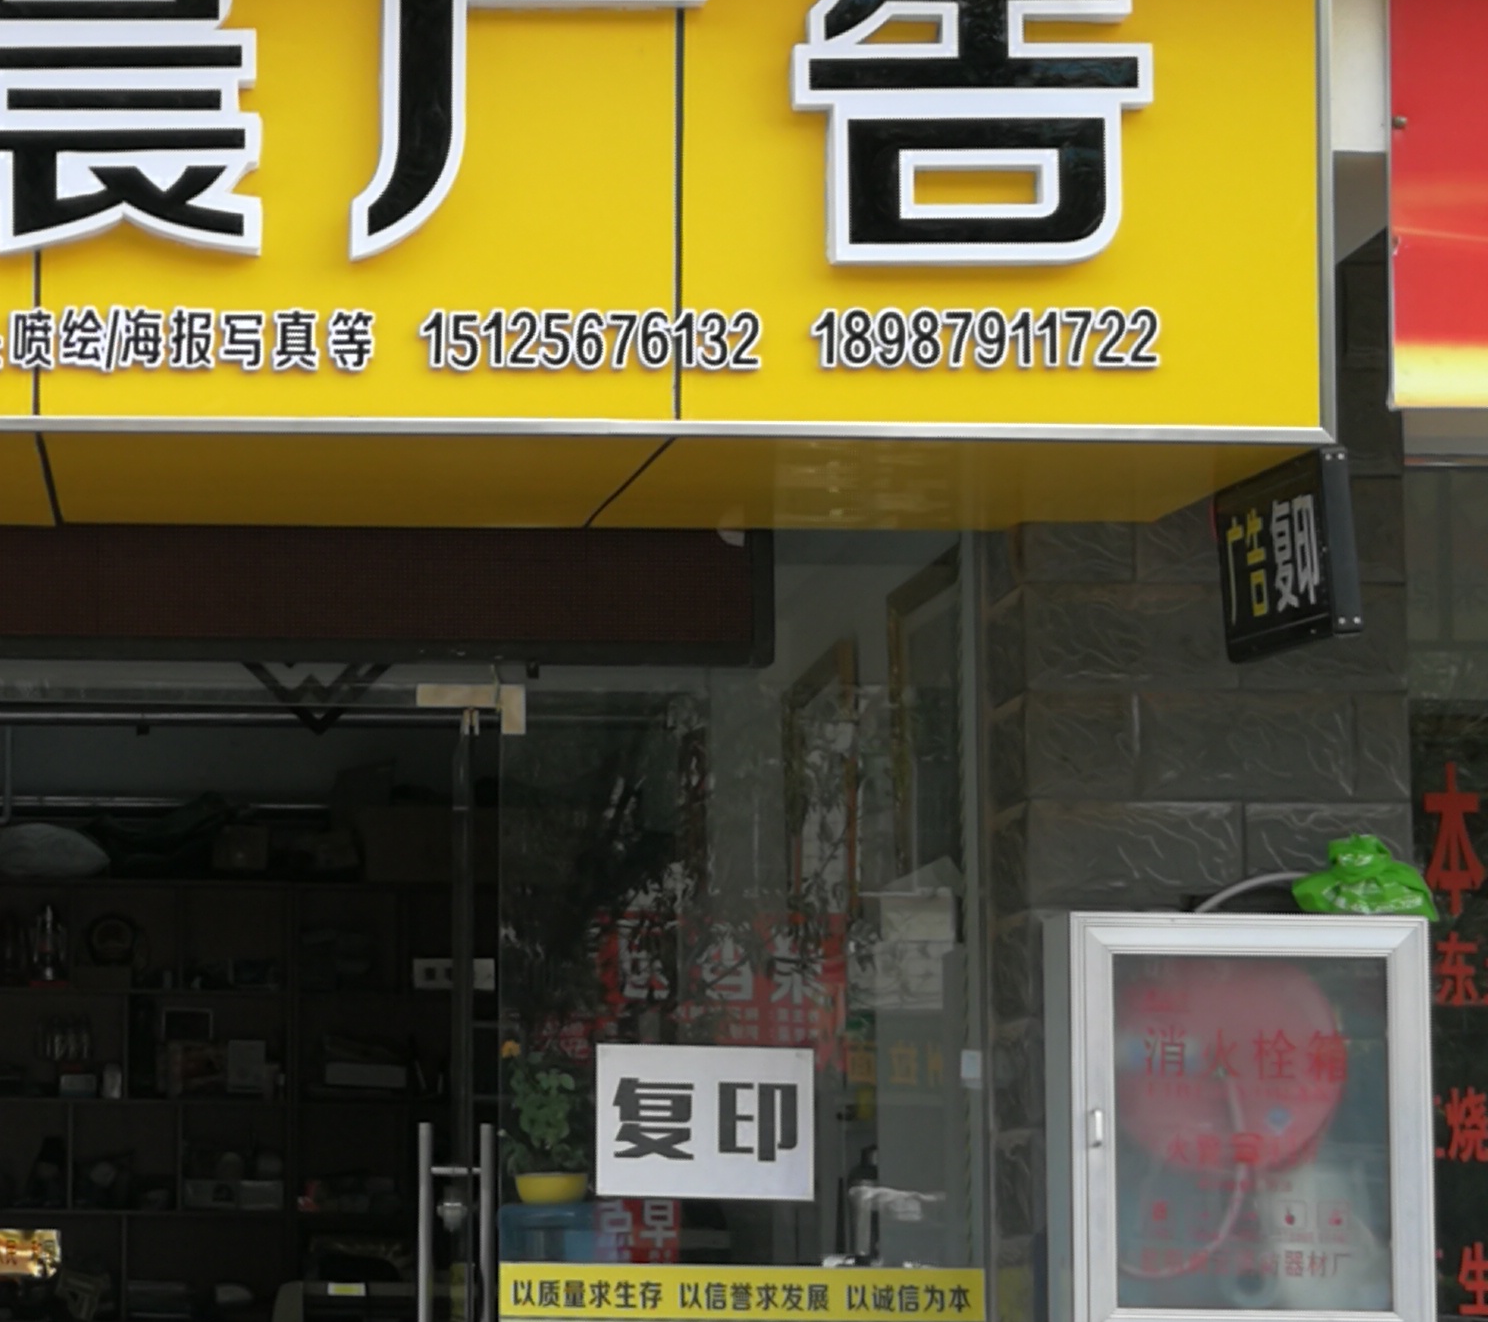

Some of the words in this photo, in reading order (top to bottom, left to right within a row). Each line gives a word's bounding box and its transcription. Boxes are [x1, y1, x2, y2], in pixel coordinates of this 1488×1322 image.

[419, 308, 761, 372] 15125676132
[810, 306, 1160, 370] 18987911722
[1143, 1026, 1350, 1084] 消火栓箱
[612, 1076, 799, 1163] 复印
[511, 1279, 663, 1311] 以质量求生存
[678, 1281, 830, 1313] 以信誉求发展
[846, 1283, 972, 1314] 以诚信为本
